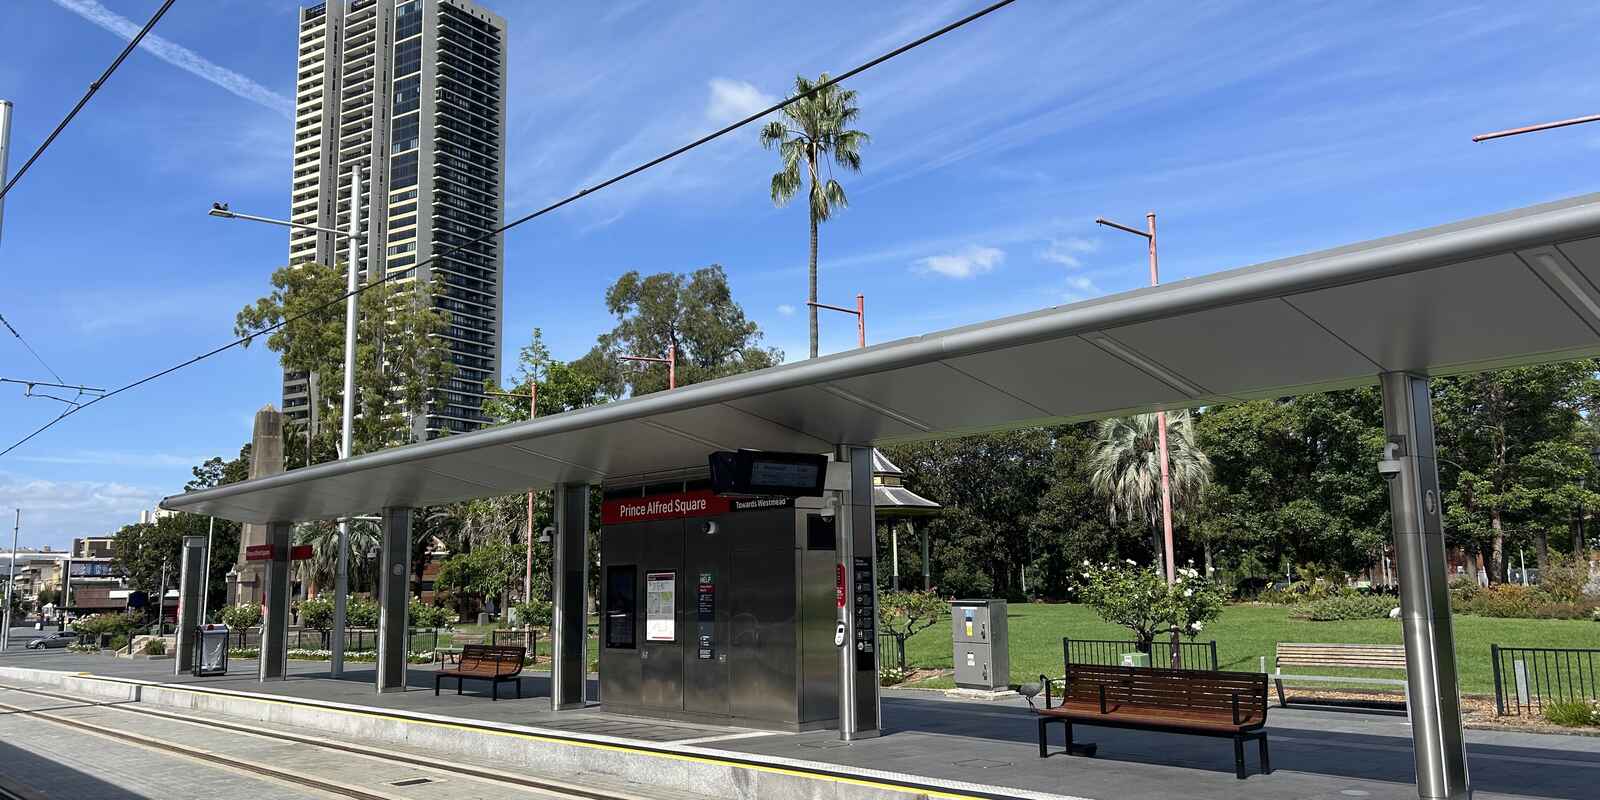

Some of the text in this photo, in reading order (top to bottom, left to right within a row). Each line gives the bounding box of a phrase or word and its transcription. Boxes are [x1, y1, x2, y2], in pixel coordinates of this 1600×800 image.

[620, 498, 706, 517] Prince Alfred Square
[736, 498, 786, 509] Towards Westmead
